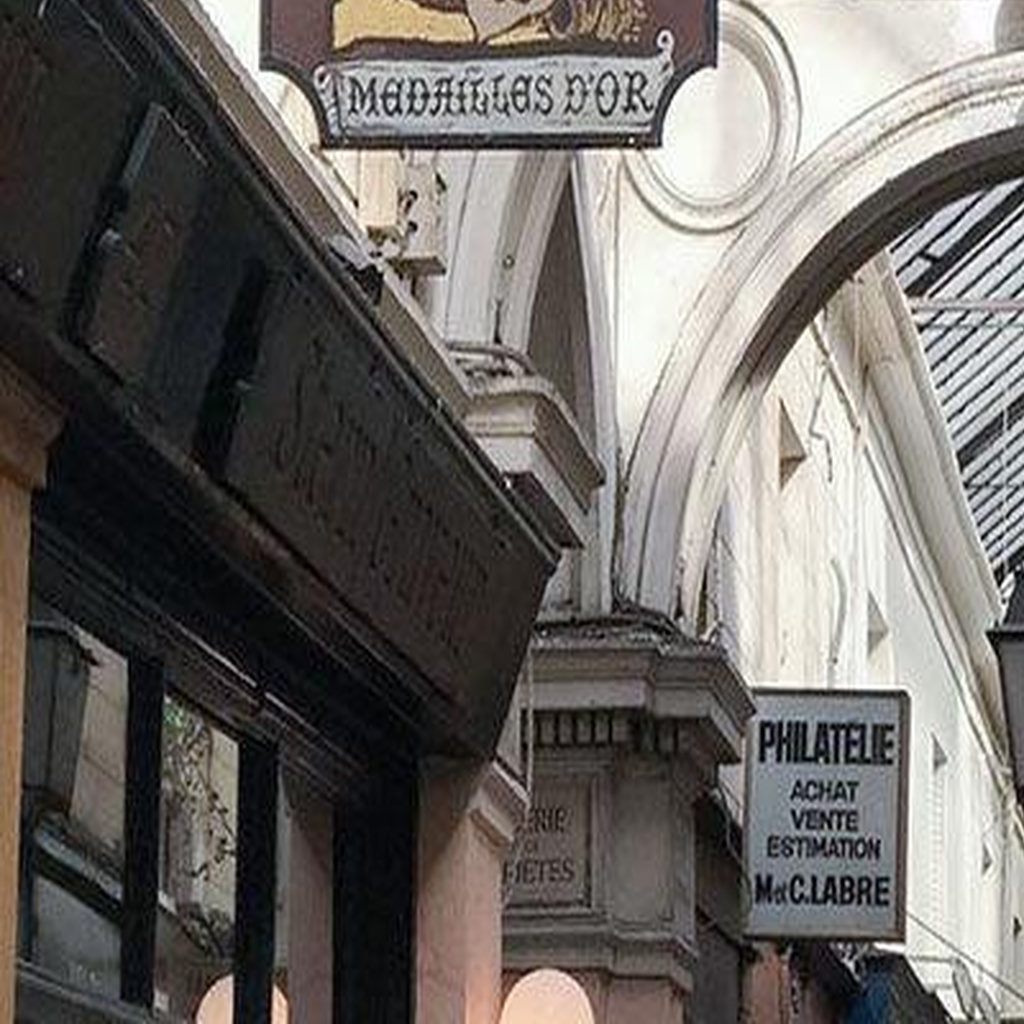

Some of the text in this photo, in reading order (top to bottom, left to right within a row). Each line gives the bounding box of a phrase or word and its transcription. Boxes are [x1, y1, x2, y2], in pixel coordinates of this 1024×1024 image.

[759, 719, 895, 765] PHILATELIE
[790, 779, 859, 802] ACHAT
[790, 809, 859, 832] VENTE
[767, 835, 881, 860] ESTIMATION
